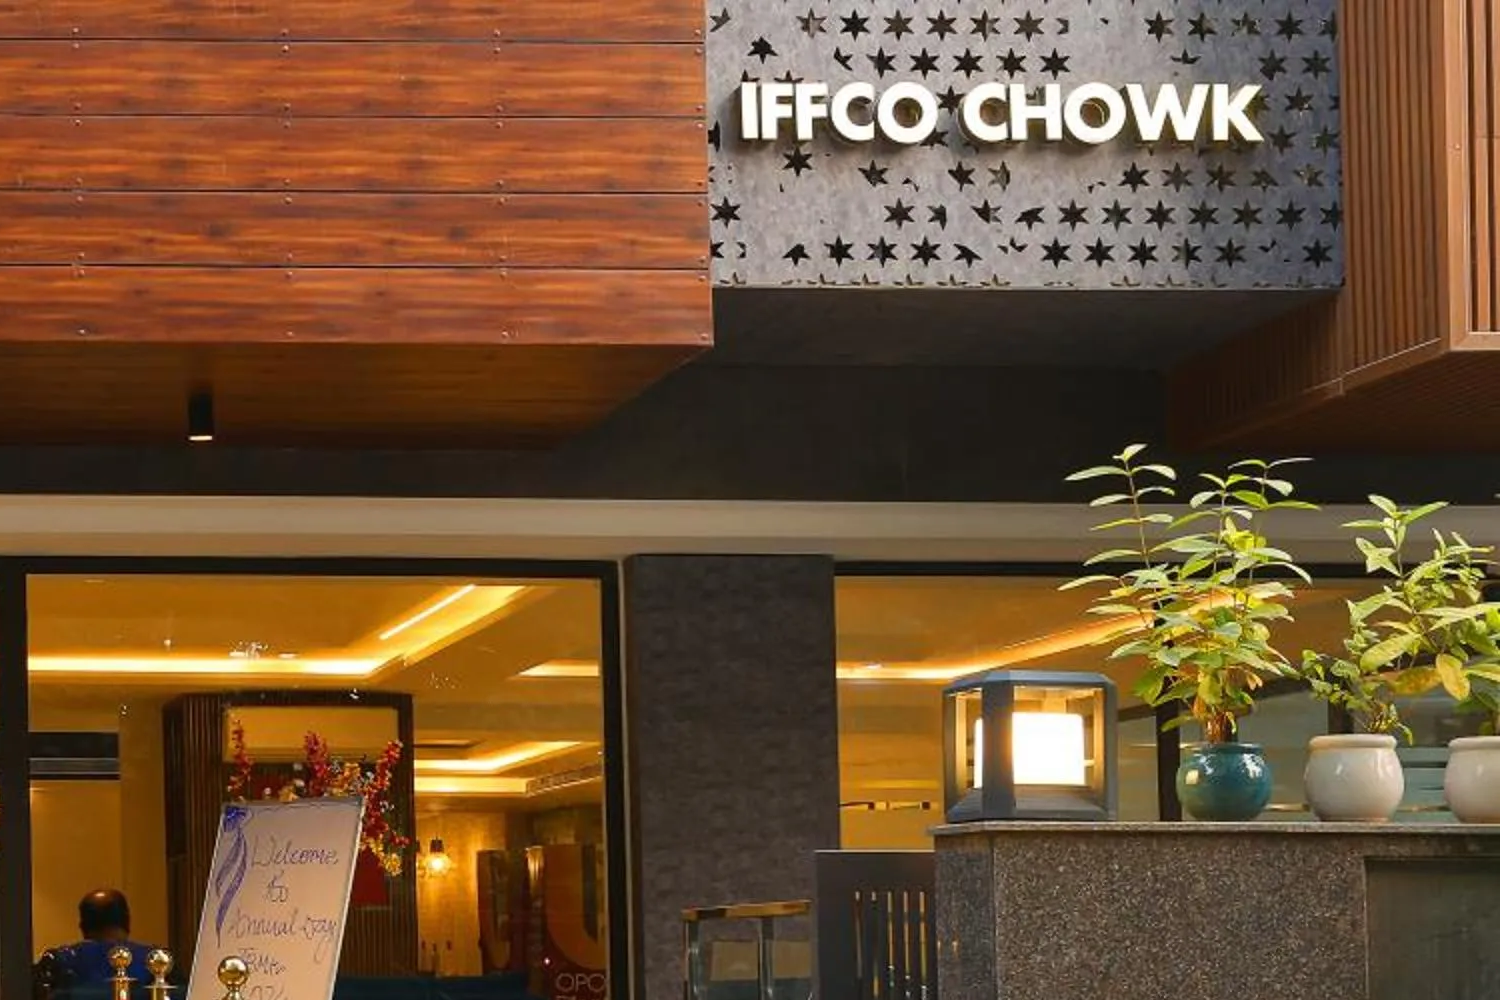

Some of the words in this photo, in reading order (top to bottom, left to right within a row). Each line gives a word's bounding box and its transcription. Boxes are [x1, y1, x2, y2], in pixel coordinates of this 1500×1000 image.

[739, 81, 937, 144] IFFCO
[960, 81, 1264, 143] CHOWK
[251, 834, 340, 867] Welcome
[556, 972, 606, 992] OPO
